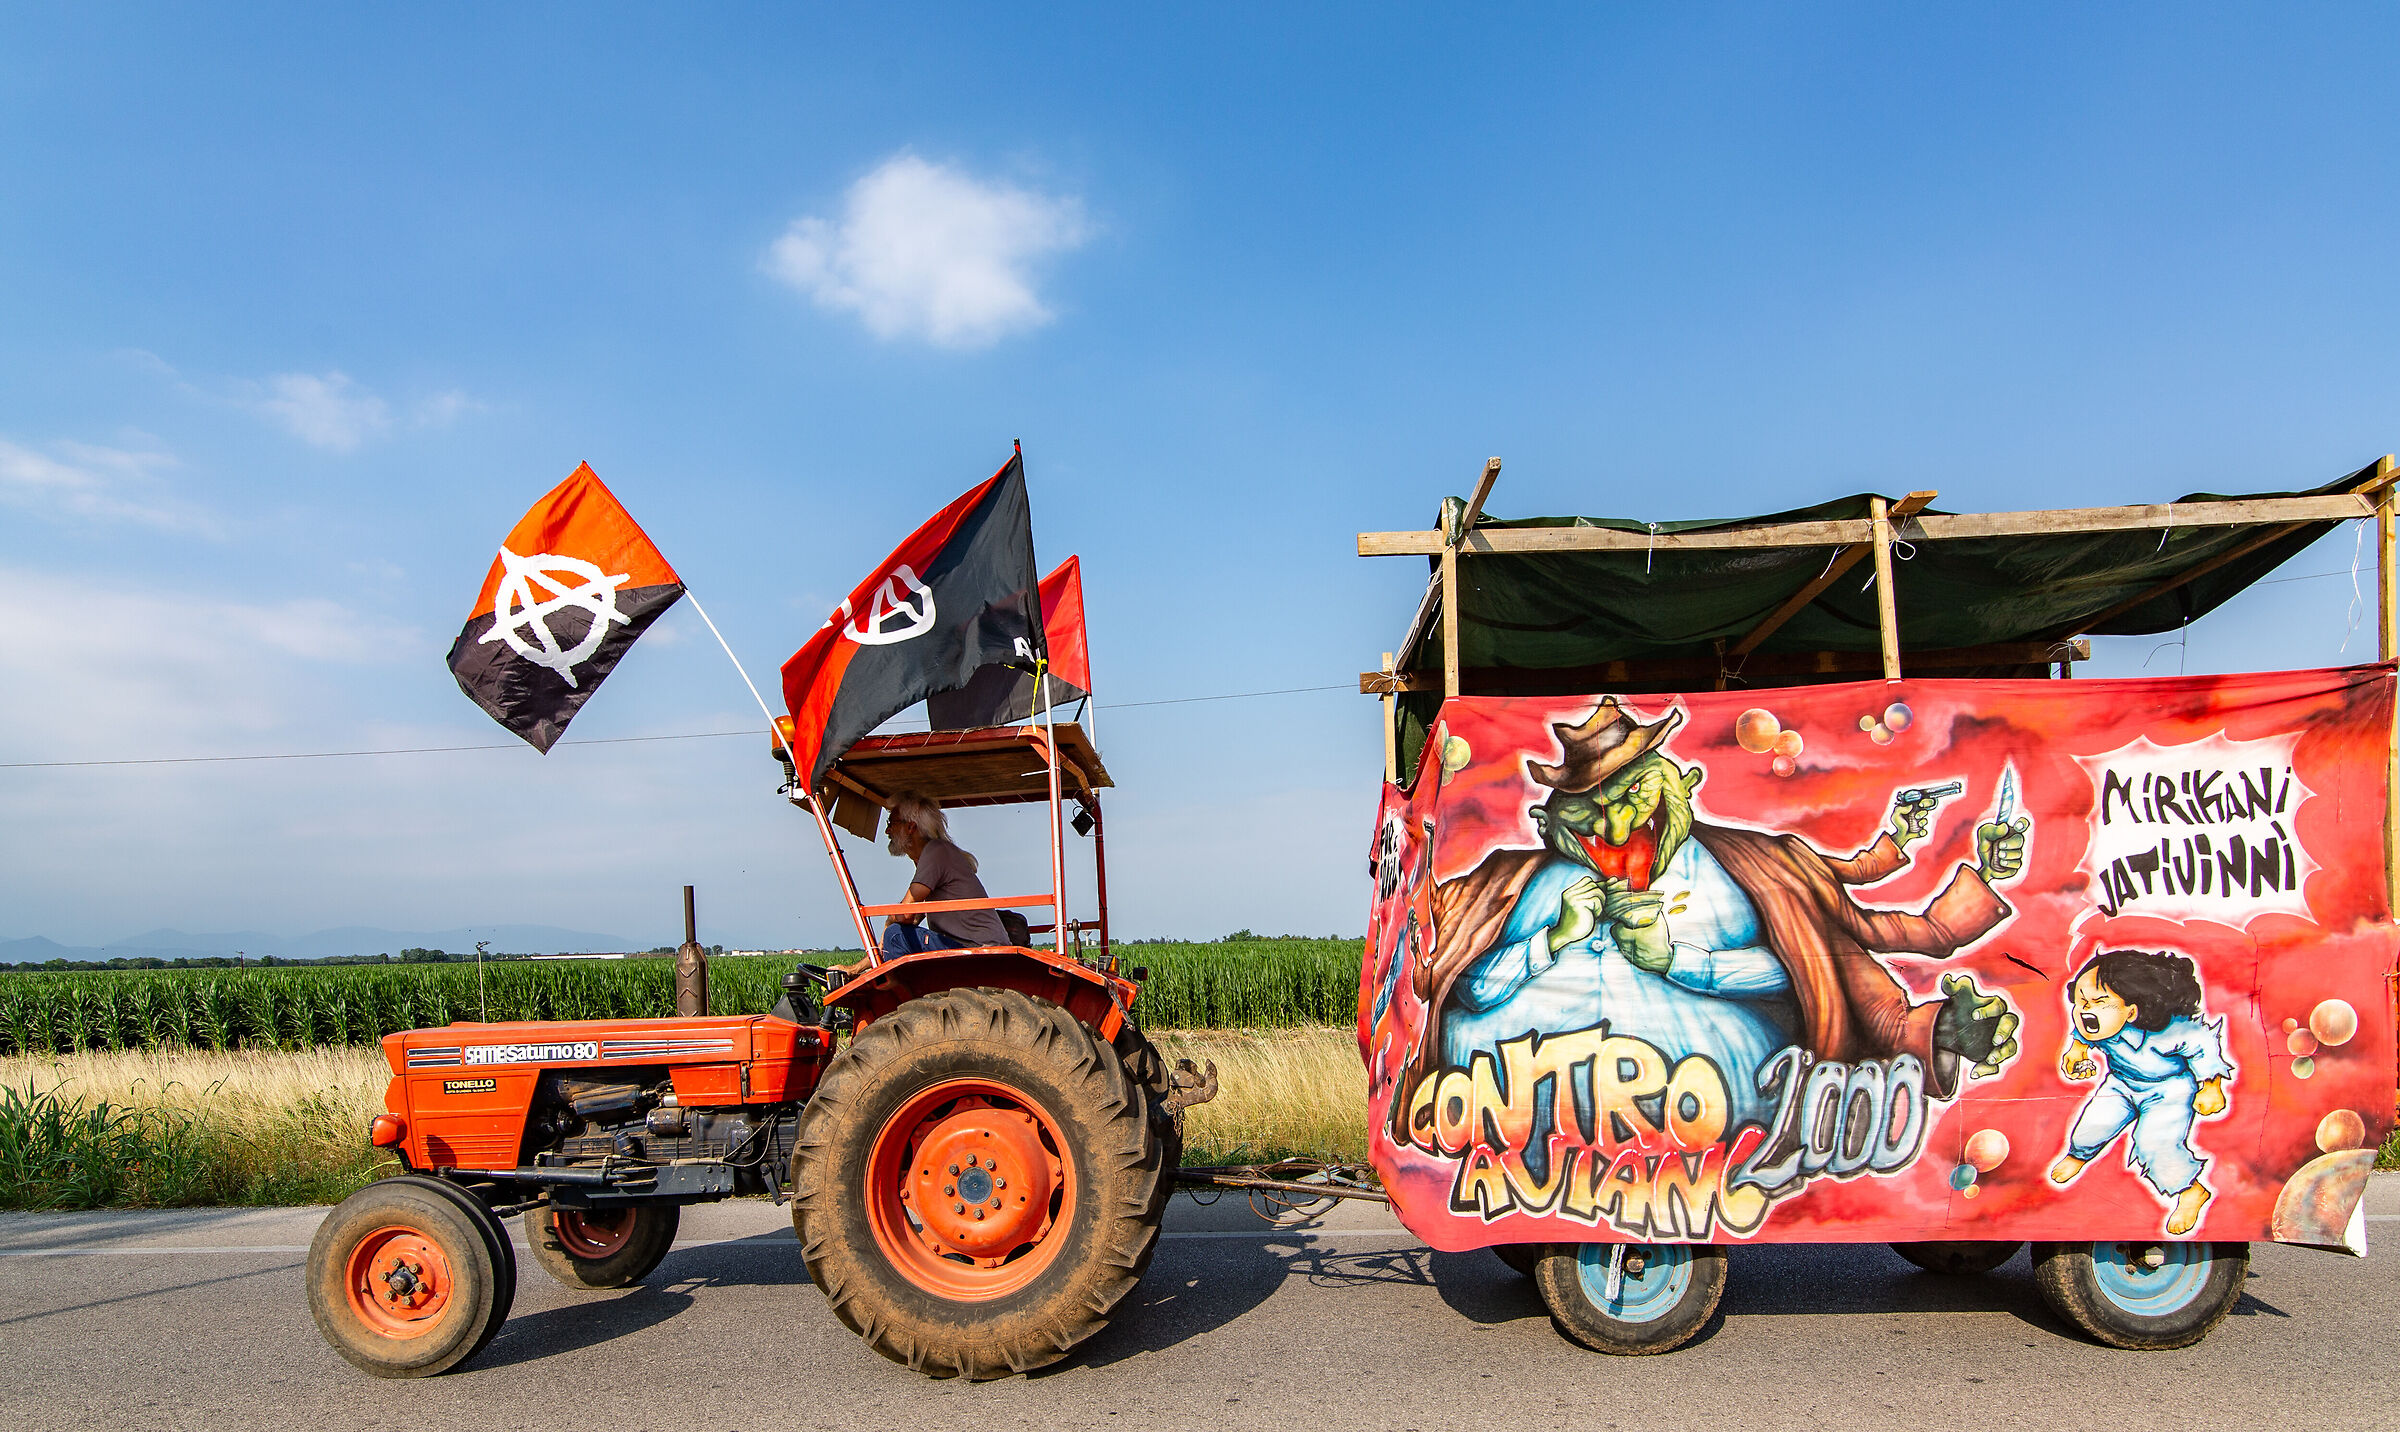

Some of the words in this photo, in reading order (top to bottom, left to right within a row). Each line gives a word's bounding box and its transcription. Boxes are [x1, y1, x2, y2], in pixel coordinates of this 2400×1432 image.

[445, 1079, 495, 1089] TONELLO
[465, 1046, 505, 1064] SAME
[573, 1042, 597, 1060] 80
[1407, 1018, 1734, 1158] CONTRO
[1725, 1045, 1929, 1200] 2000
